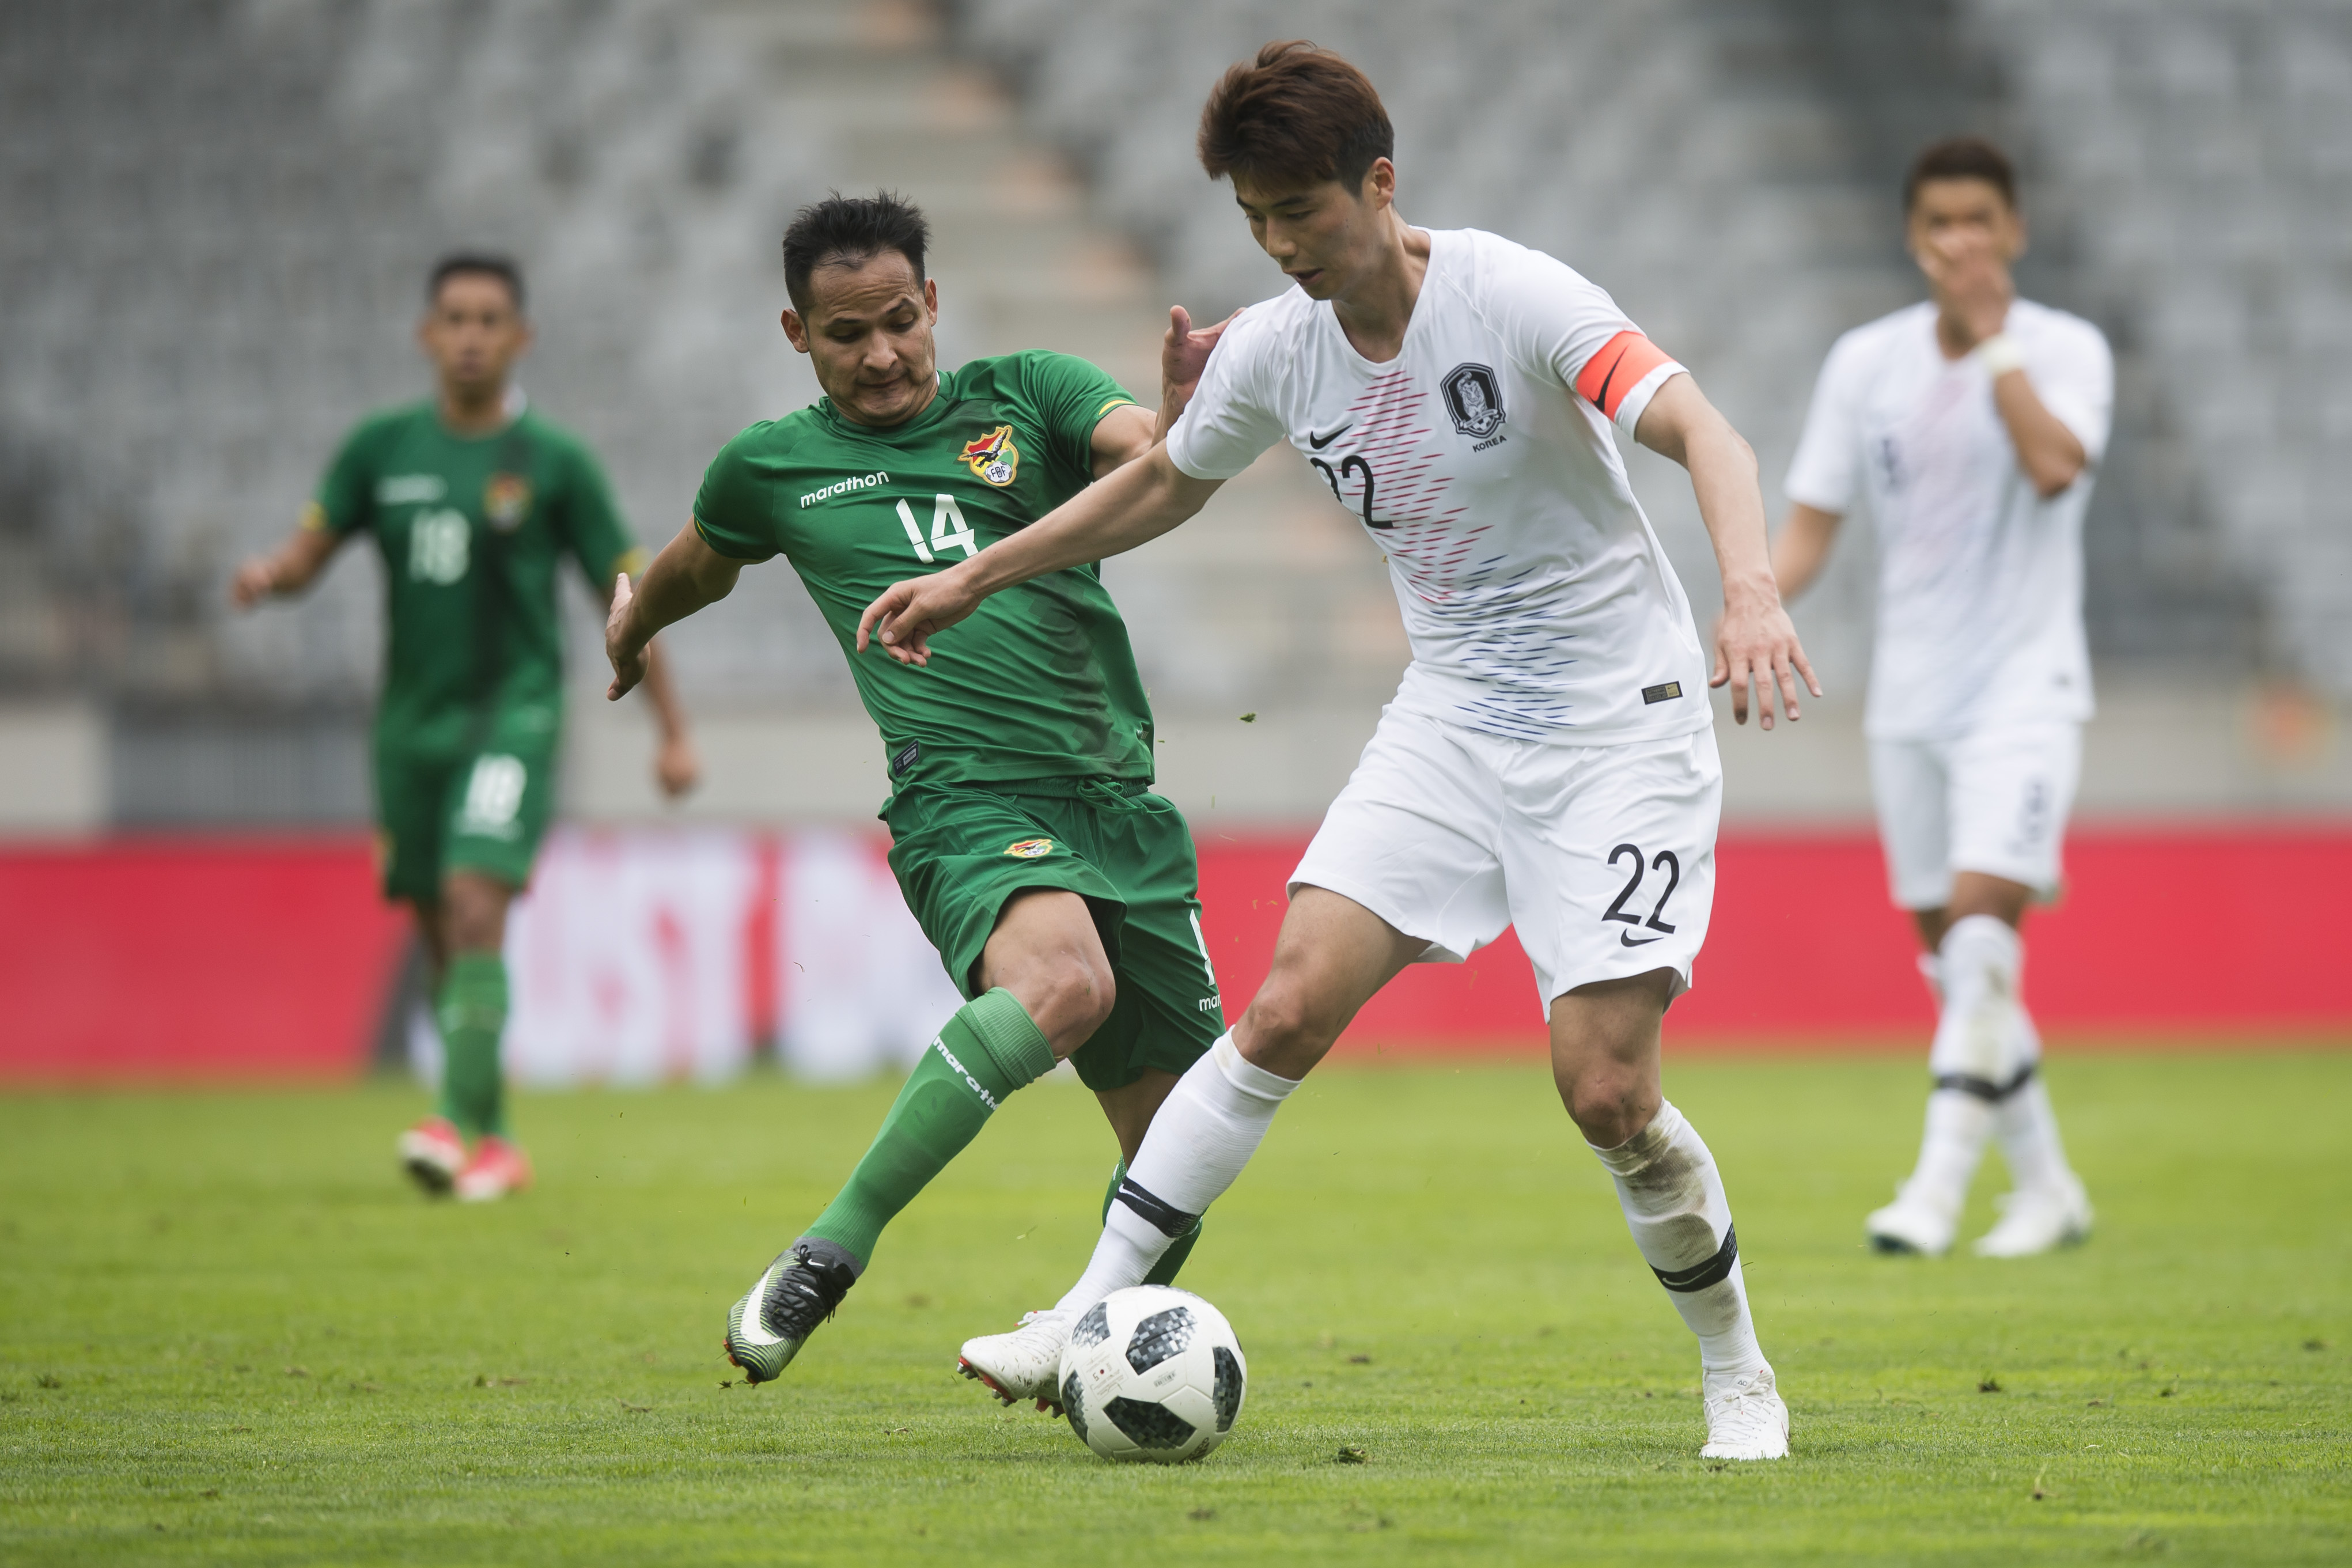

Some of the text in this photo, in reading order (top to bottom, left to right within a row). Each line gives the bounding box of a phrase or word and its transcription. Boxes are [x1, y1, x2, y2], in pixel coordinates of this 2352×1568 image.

[1472, 435, 1507, 453] KOREA
[800, 471, 889, 509] marathon
[990, 465, 1006, 478] FBF
[895, 493, 979, 564] 14
[1601, 843, 1680, 934] 22
